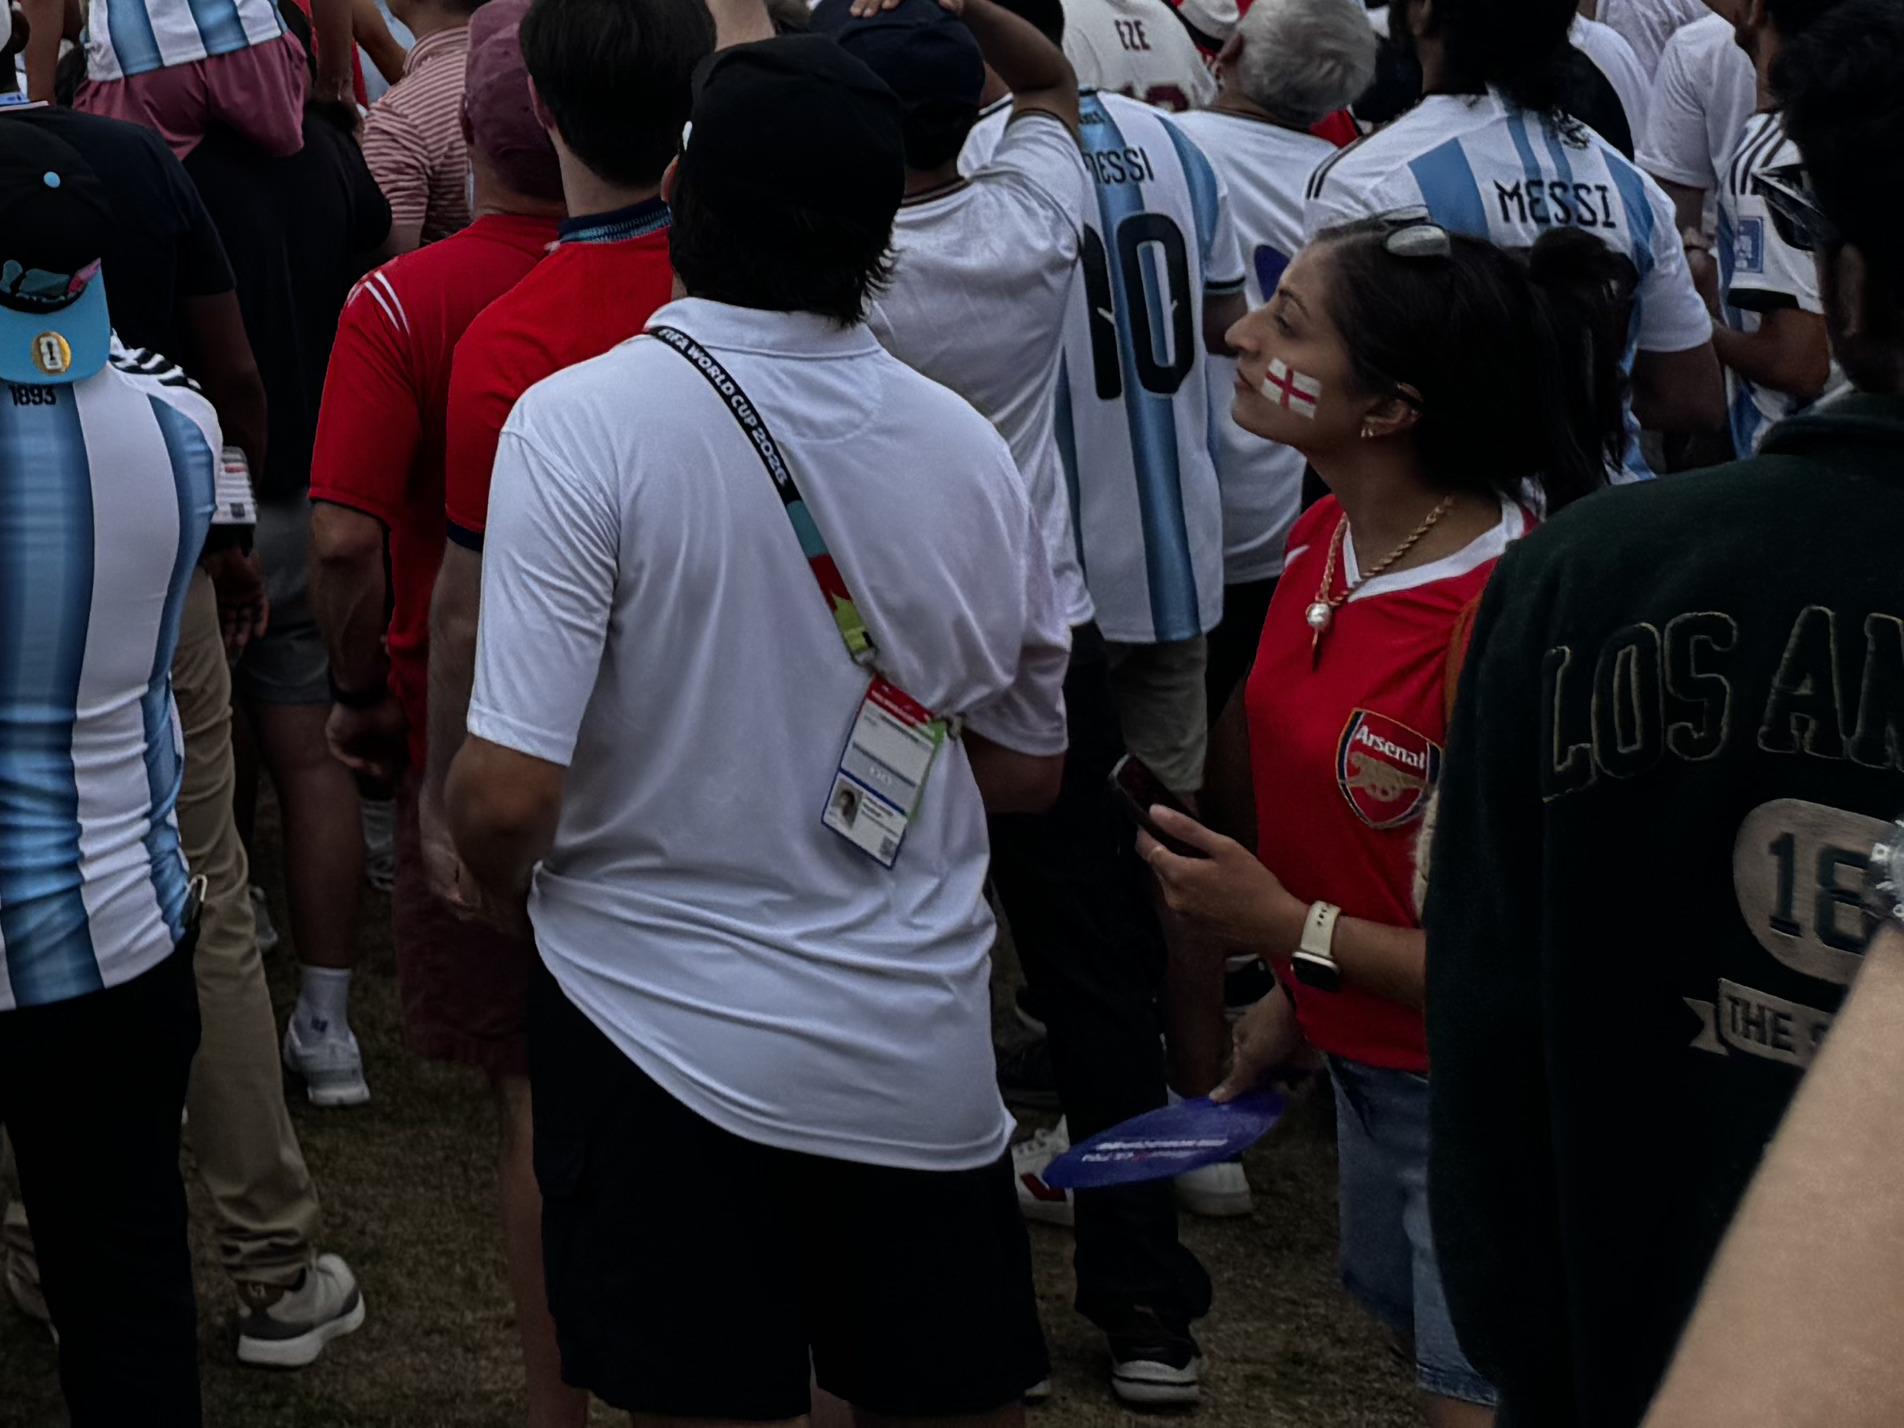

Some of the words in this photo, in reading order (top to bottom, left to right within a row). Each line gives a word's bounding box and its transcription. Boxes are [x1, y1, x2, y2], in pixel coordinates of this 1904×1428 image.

[1114, 19, 1151, 51] EZE
[1493, 179, 1617, 228] MESSI
[1081, 212, 1195, 400] 10
[7, 384, 57, 407] 1893
[658, 327, 690, 350] FIFA
[687, 344, 736, 396] WORLD
[731, 394, 759, 428] CUP
[751, 426, 789, 488] 2026
[1542, 610, 1740, 804] LOS
[1354, 725, 1426, 771] Arsenal
[1727, 995, 1797, 1053] THE
